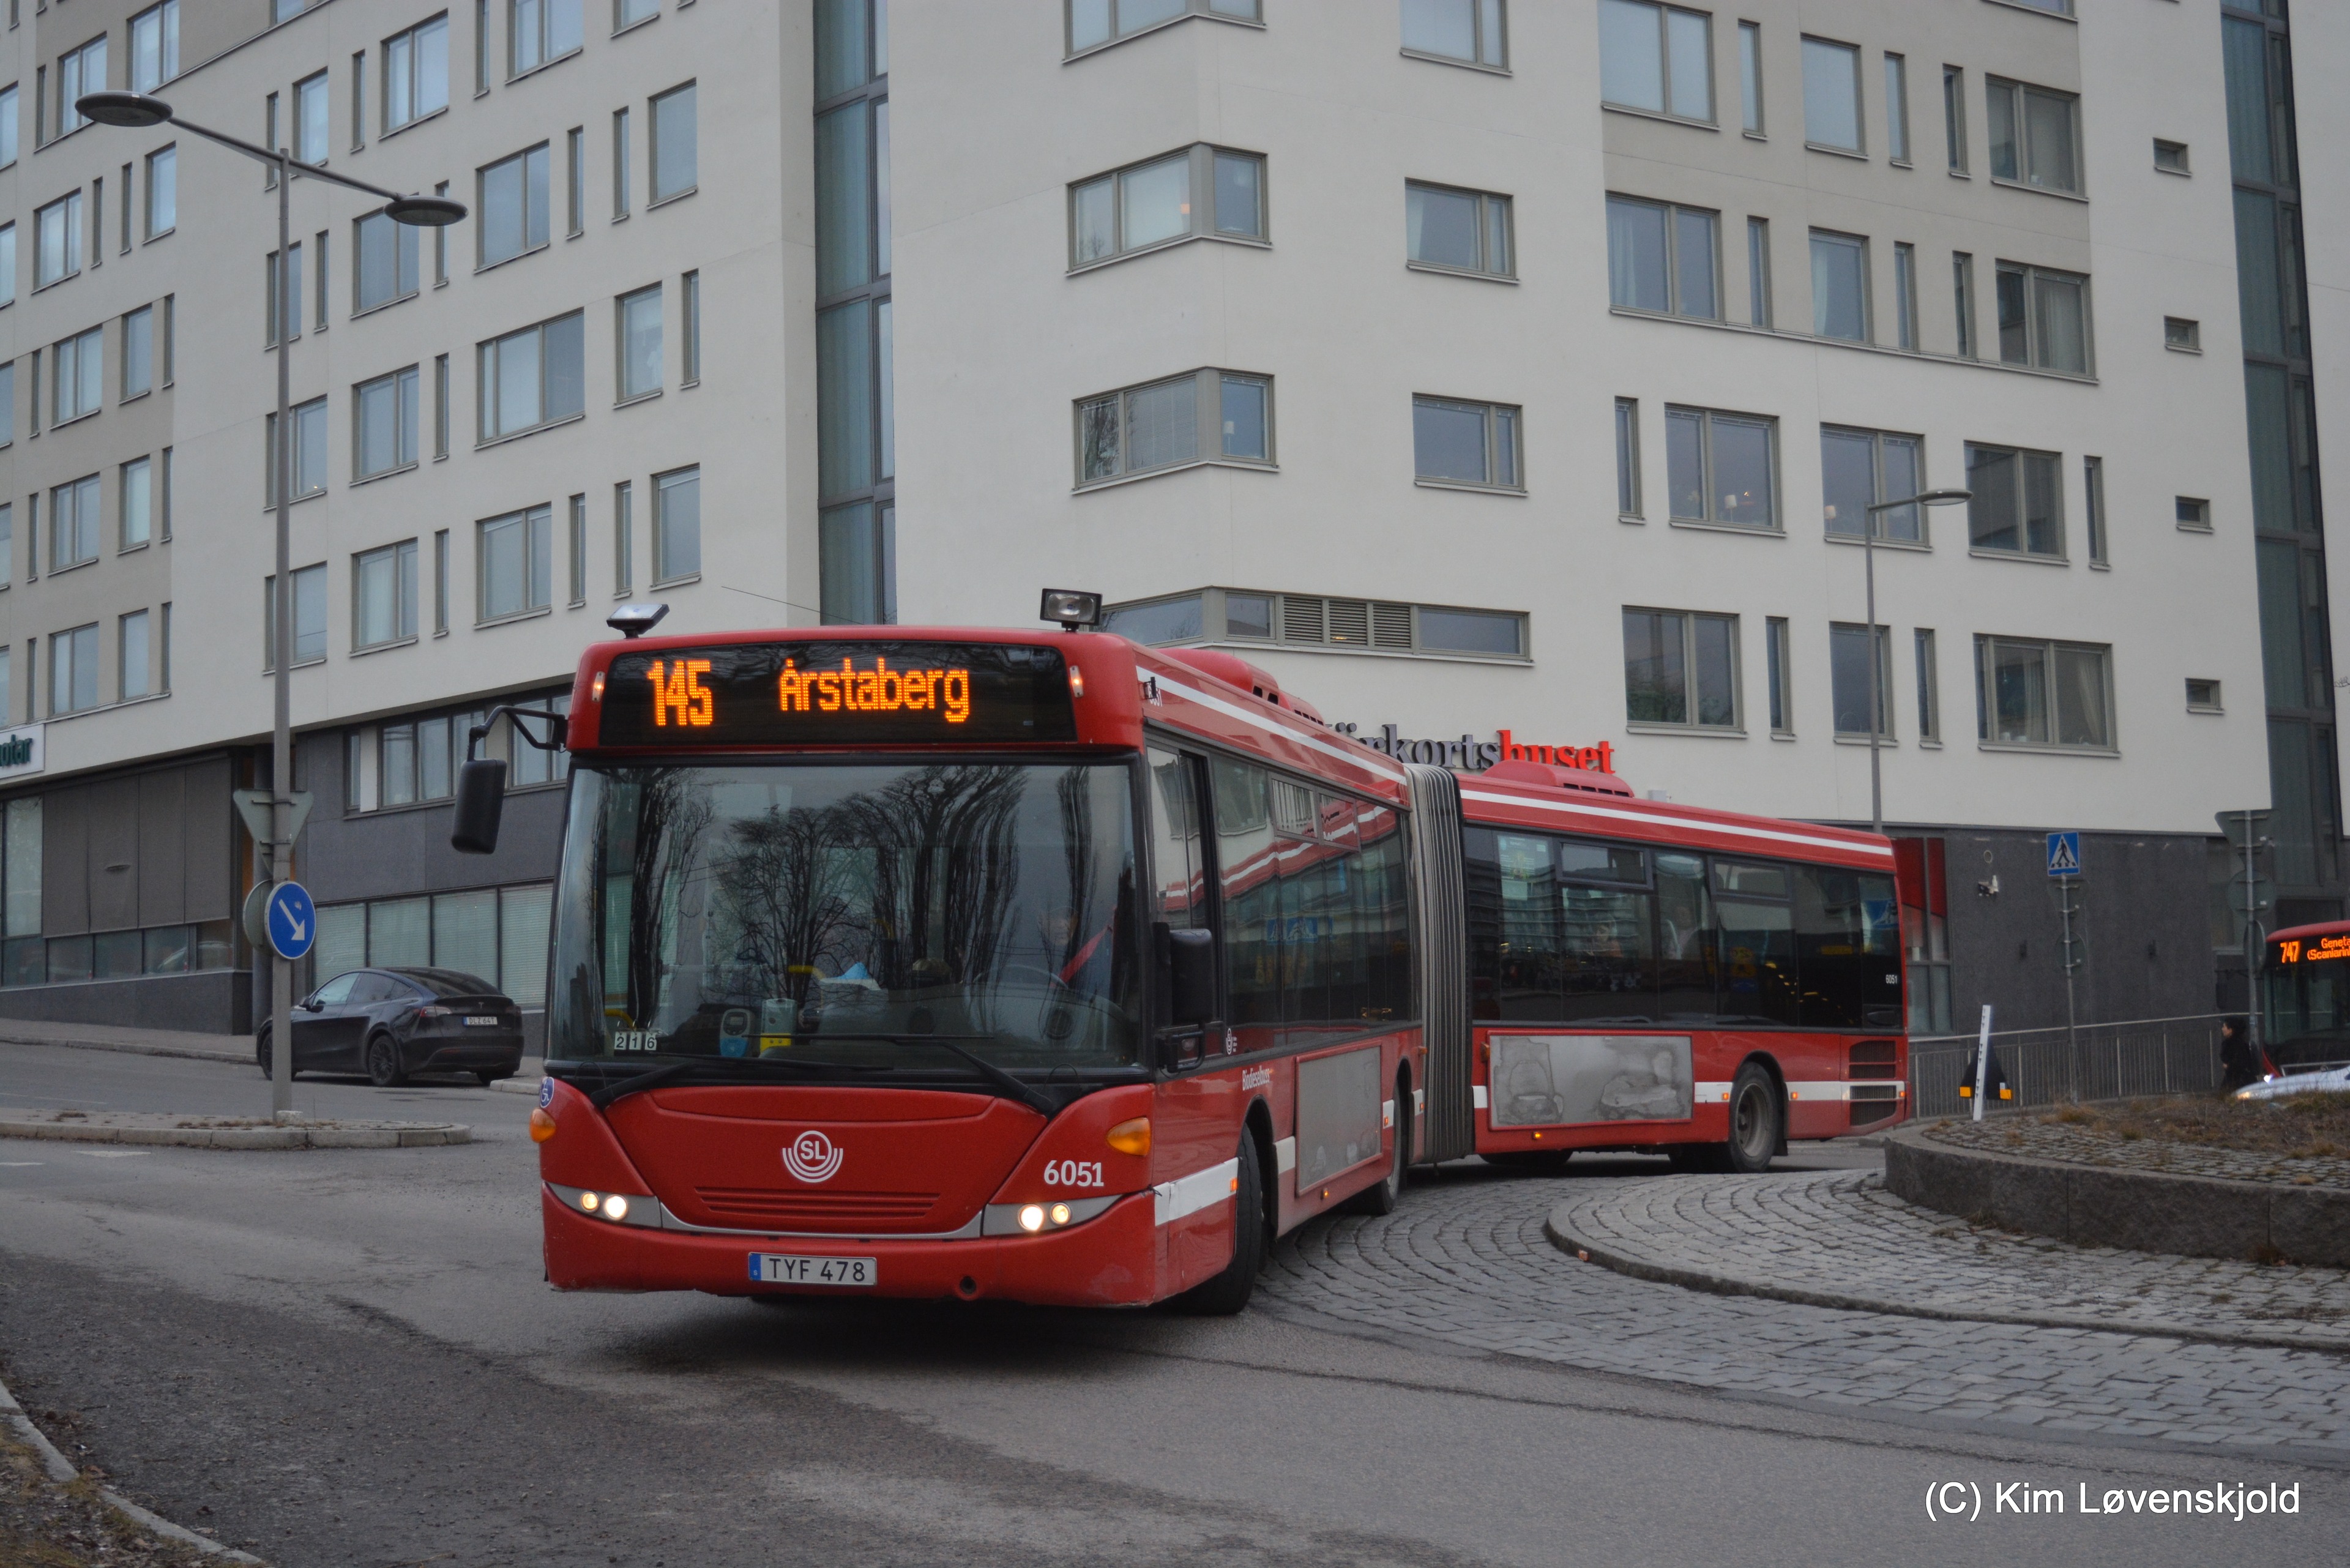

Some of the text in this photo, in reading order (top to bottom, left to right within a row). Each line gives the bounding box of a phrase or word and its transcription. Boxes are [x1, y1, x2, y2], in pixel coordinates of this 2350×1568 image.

[646, 659, 714, 727] 145
[778, 657, 970, 723] Årstaberg
[1325, 722, 1616, 775] rkortshuset
[2280, 941, 2300, 964] 747
[2307, 946, 2350, 960] (Scaniarin
[1886, 974, 1897, 984] 6051
[616, 1036, 655, 1049] 216
[1242, 1065, 1270, 1091] Biodieselbuss
[800, 1140, 826, 1160] SL
[1043, 1160, 1105, 1187] 6051
[769, 1258, 811, 1280] TYF
[820, 1261, 865, 1282] 478
